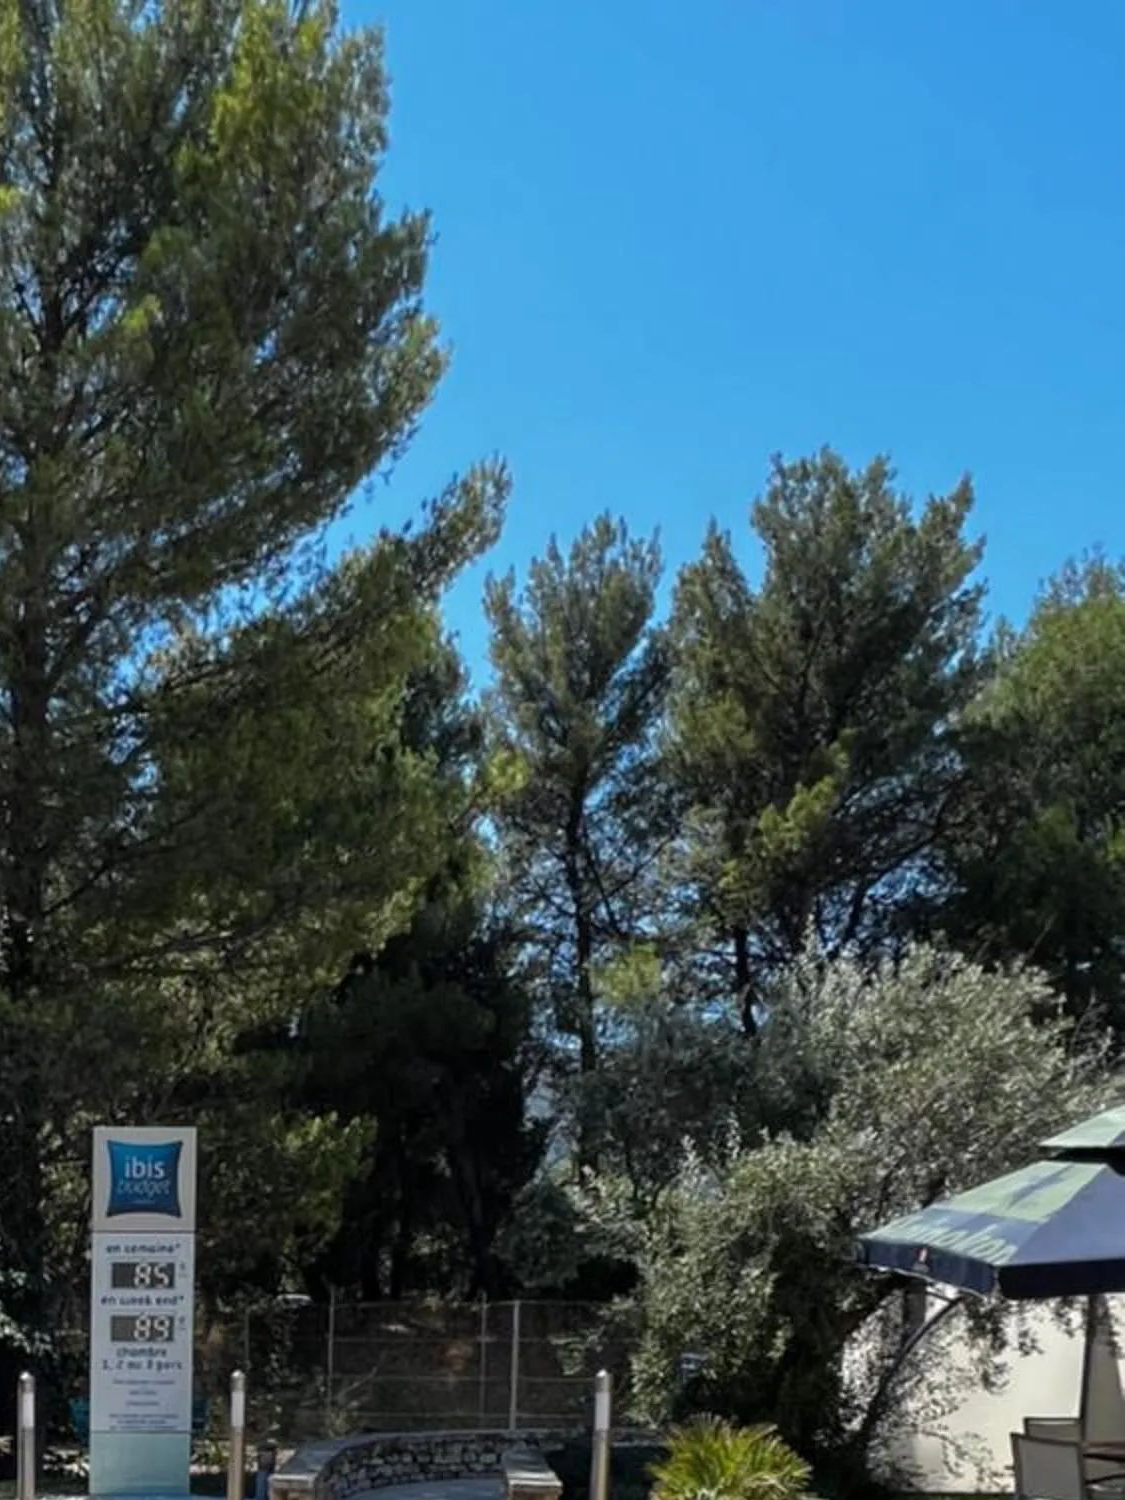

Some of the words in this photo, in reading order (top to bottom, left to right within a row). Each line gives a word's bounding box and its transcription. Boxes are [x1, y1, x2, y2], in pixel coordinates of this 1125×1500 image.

[124, 1154, 166, 1179] ibis
[117, 1178, 171, 1199] budget
[134, 1262, 170, 1288] 85
[134, 1314, 170, 1341] 89
